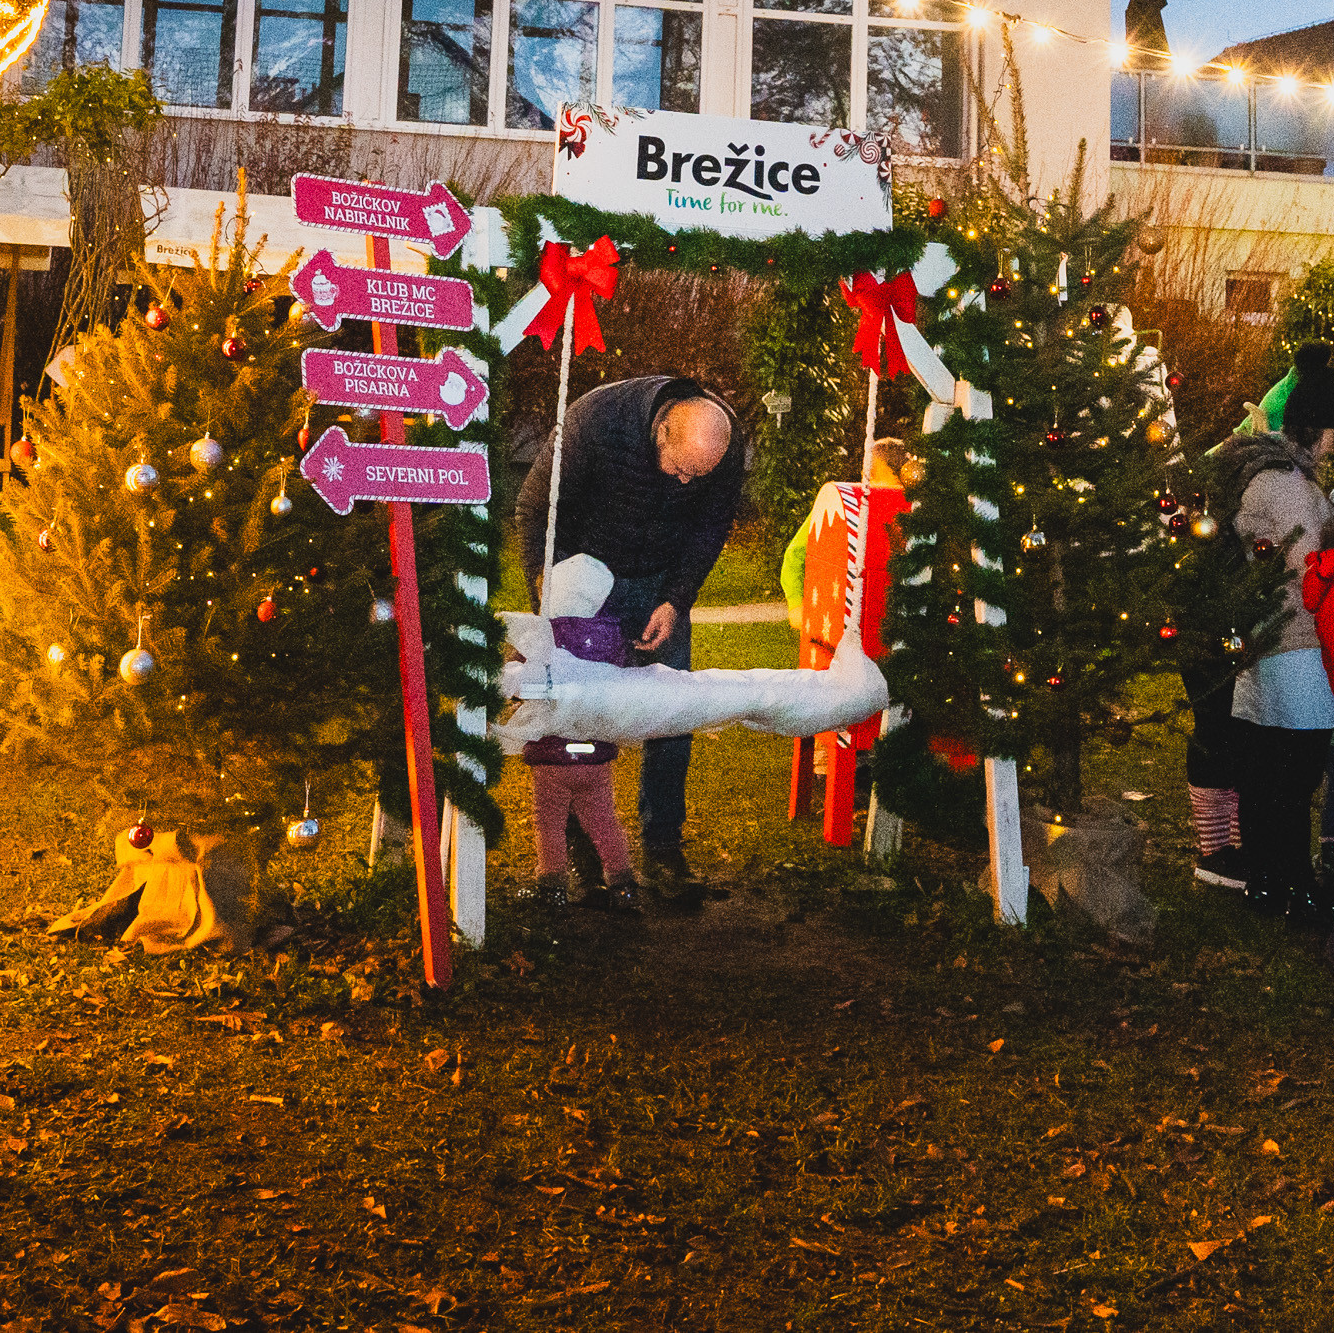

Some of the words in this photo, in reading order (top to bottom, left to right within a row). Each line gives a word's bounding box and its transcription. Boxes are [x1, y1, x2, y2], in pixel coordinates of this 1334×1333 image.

[636, 135, 821, 201] Brežice
[331, 191, 401, 214] BOŽIČKOV
[665, 188, 712, 211] Time
[720, 191, 747, 215] for
[752, 201, 789, 217] me.
[323, 205, 411, 231] NABIRALNIK
[156, 244, 193, 258] Brežic
[366, 278, 409, 298] KLUB
[412, 285, 436, 301] MC
[370, 296, 435, 319] BREŽICE
[333, 359, 419, 382] BOŽIČKOVA
[344, 378, 411, 398] PISARNA
[366, 465, 436, 484] SEVERNI
[438, 468, 469, 486] POL
